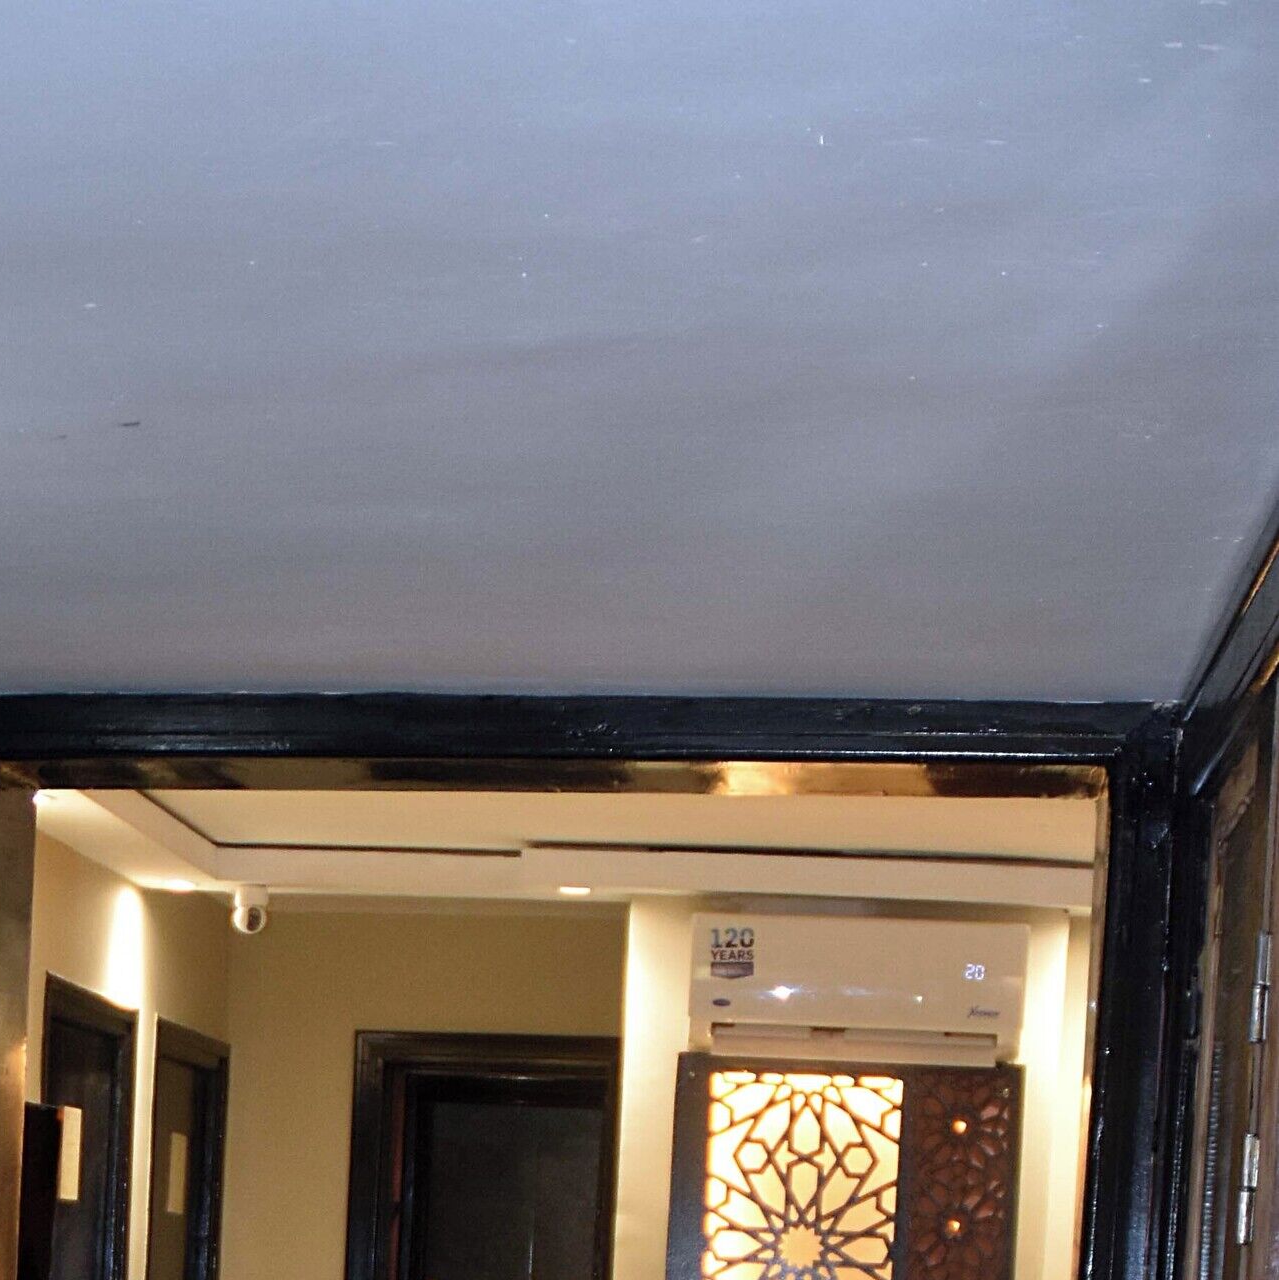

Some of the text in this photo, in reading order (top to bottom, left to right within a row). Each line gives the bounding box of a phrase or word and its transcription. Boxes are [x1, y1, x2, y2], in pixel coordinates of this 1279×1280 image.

[711, 927, 754, 948] 120
[711, 949, 754, 961] YEARS
[965, 963, 985, 980] 20
